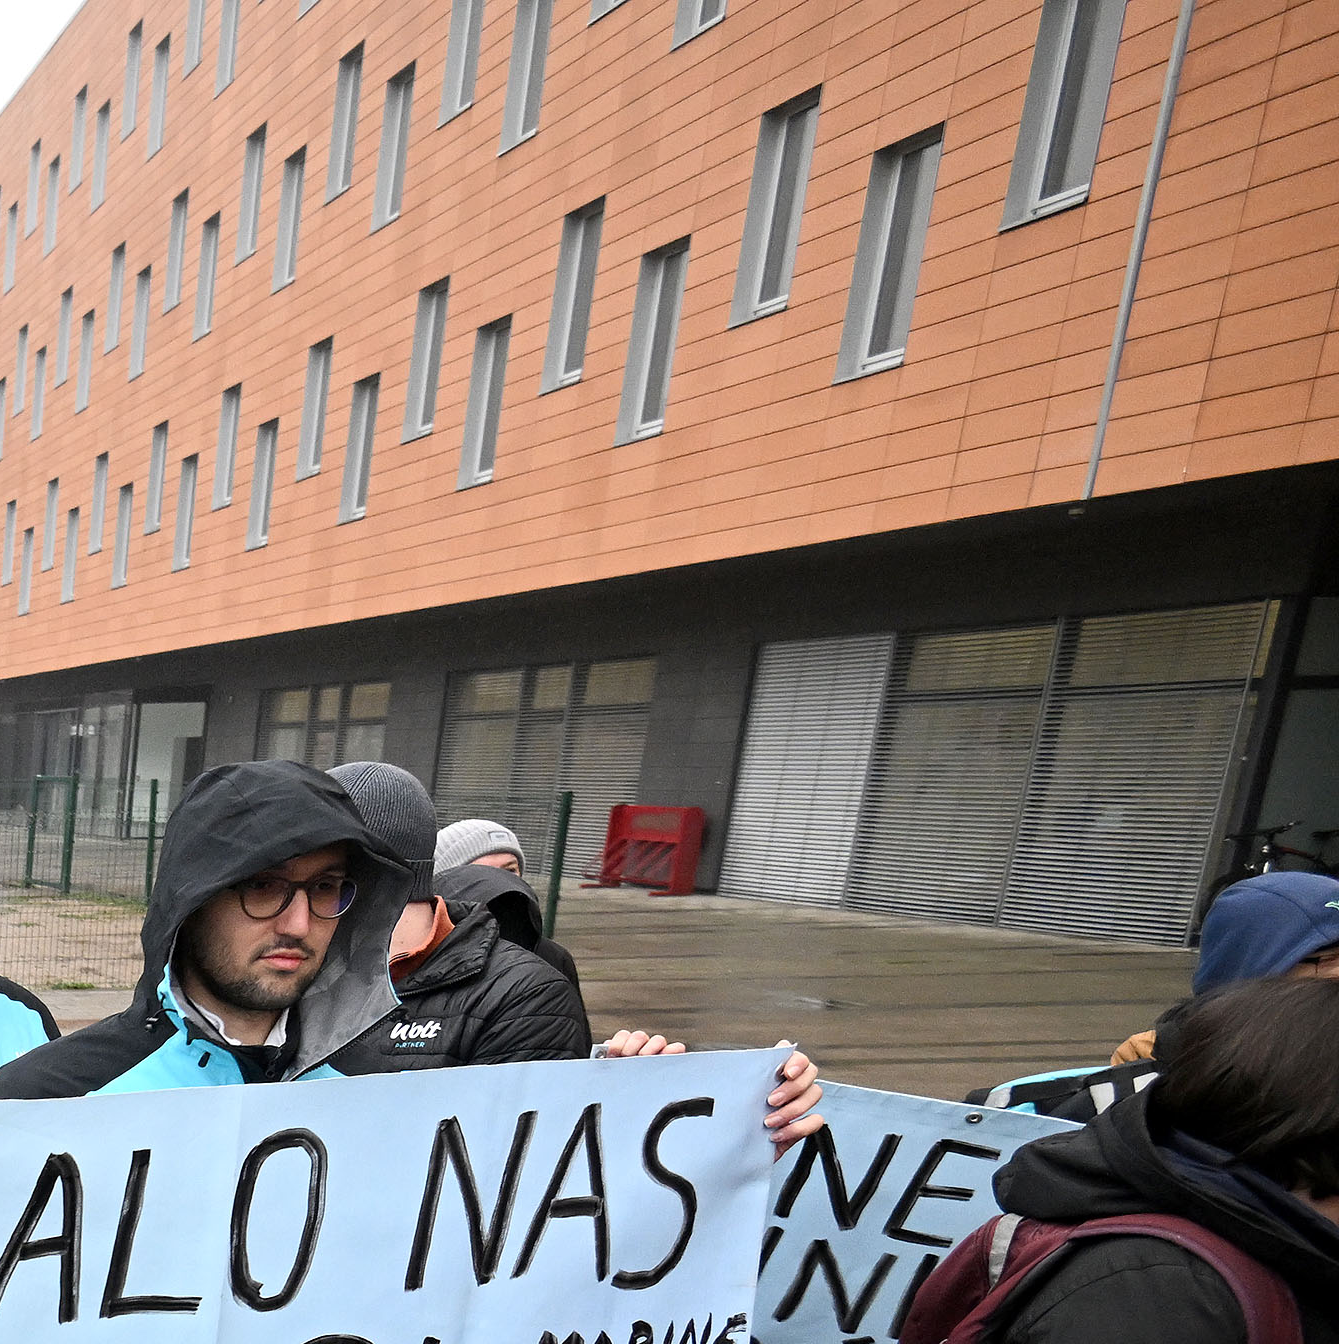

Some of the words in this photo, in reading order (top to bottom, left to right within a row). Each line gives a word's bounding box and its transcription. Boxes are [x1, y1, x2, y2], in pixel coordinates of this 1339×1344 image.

[390, 1020, 441, 1040] Wolt
[404, 1096, 715, 1292] NAS
[758, 1225, 940, 1340] NI
